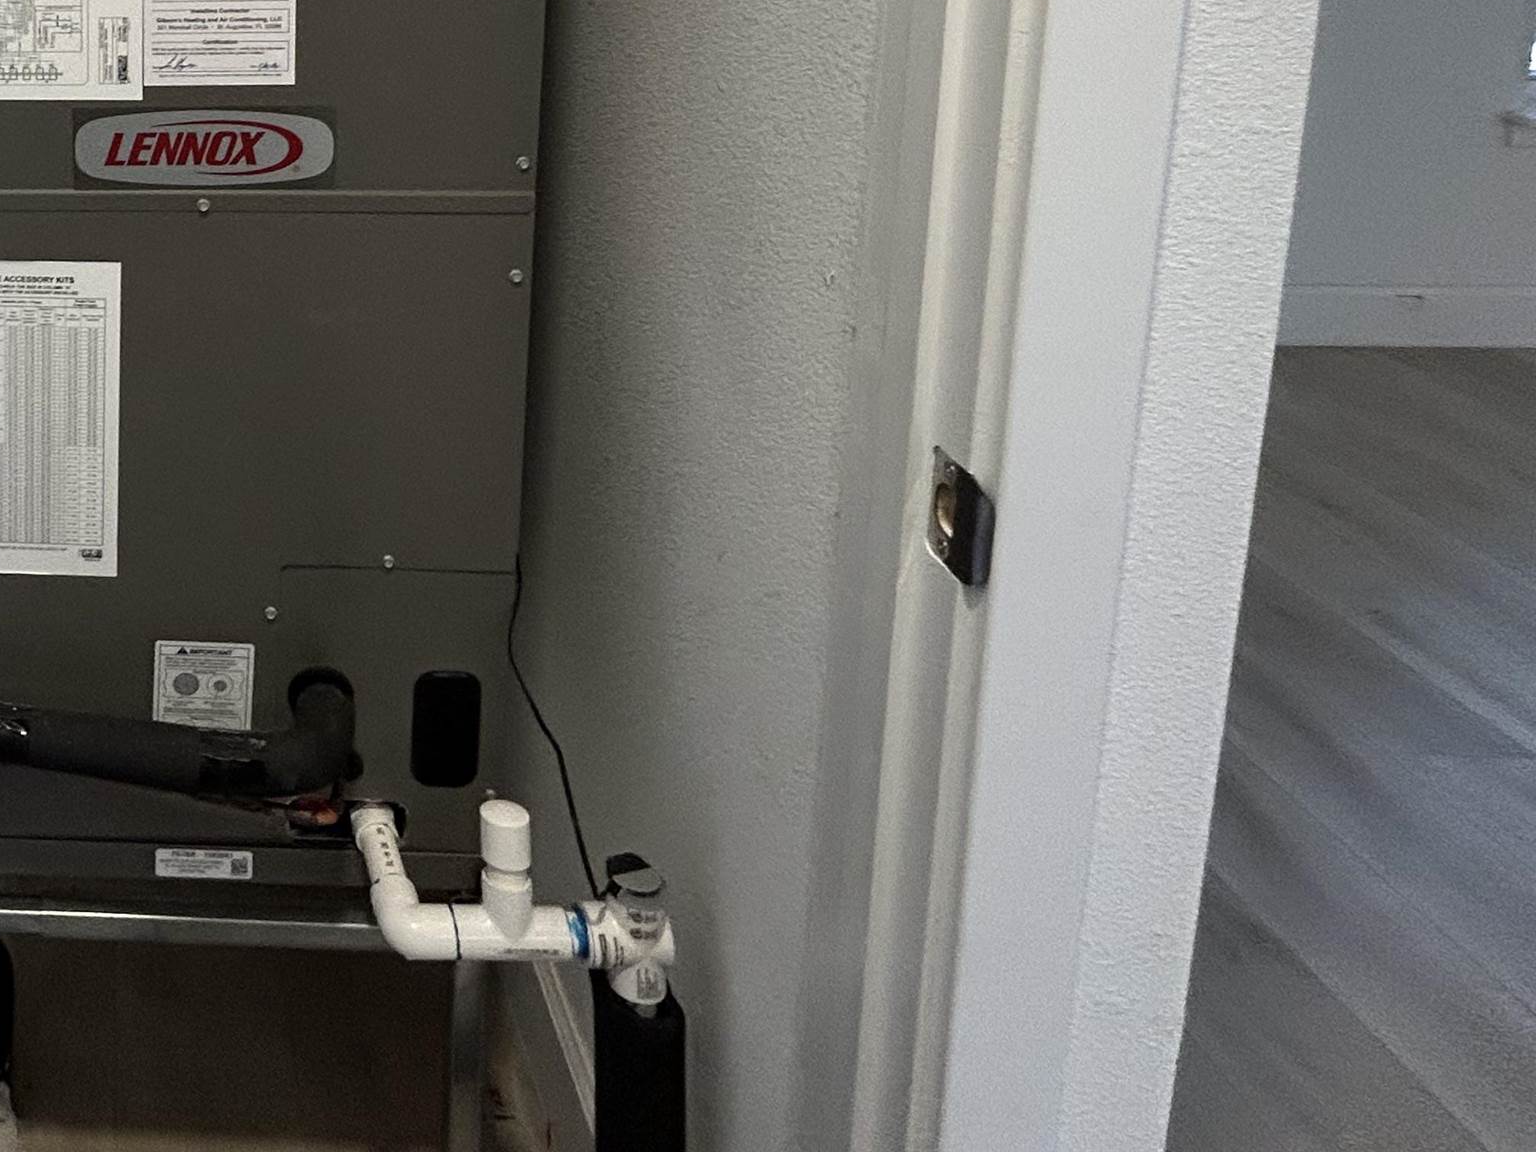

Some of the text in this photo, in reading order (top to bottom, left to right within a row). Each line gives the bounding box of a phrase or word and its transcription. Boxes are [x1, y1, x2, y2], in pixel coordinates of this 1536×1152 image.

[104, 131, 265, 166] LENNOX
[3, 275, 54, 283] ACCESSORY
[56, 276, 75, 284] KITS
